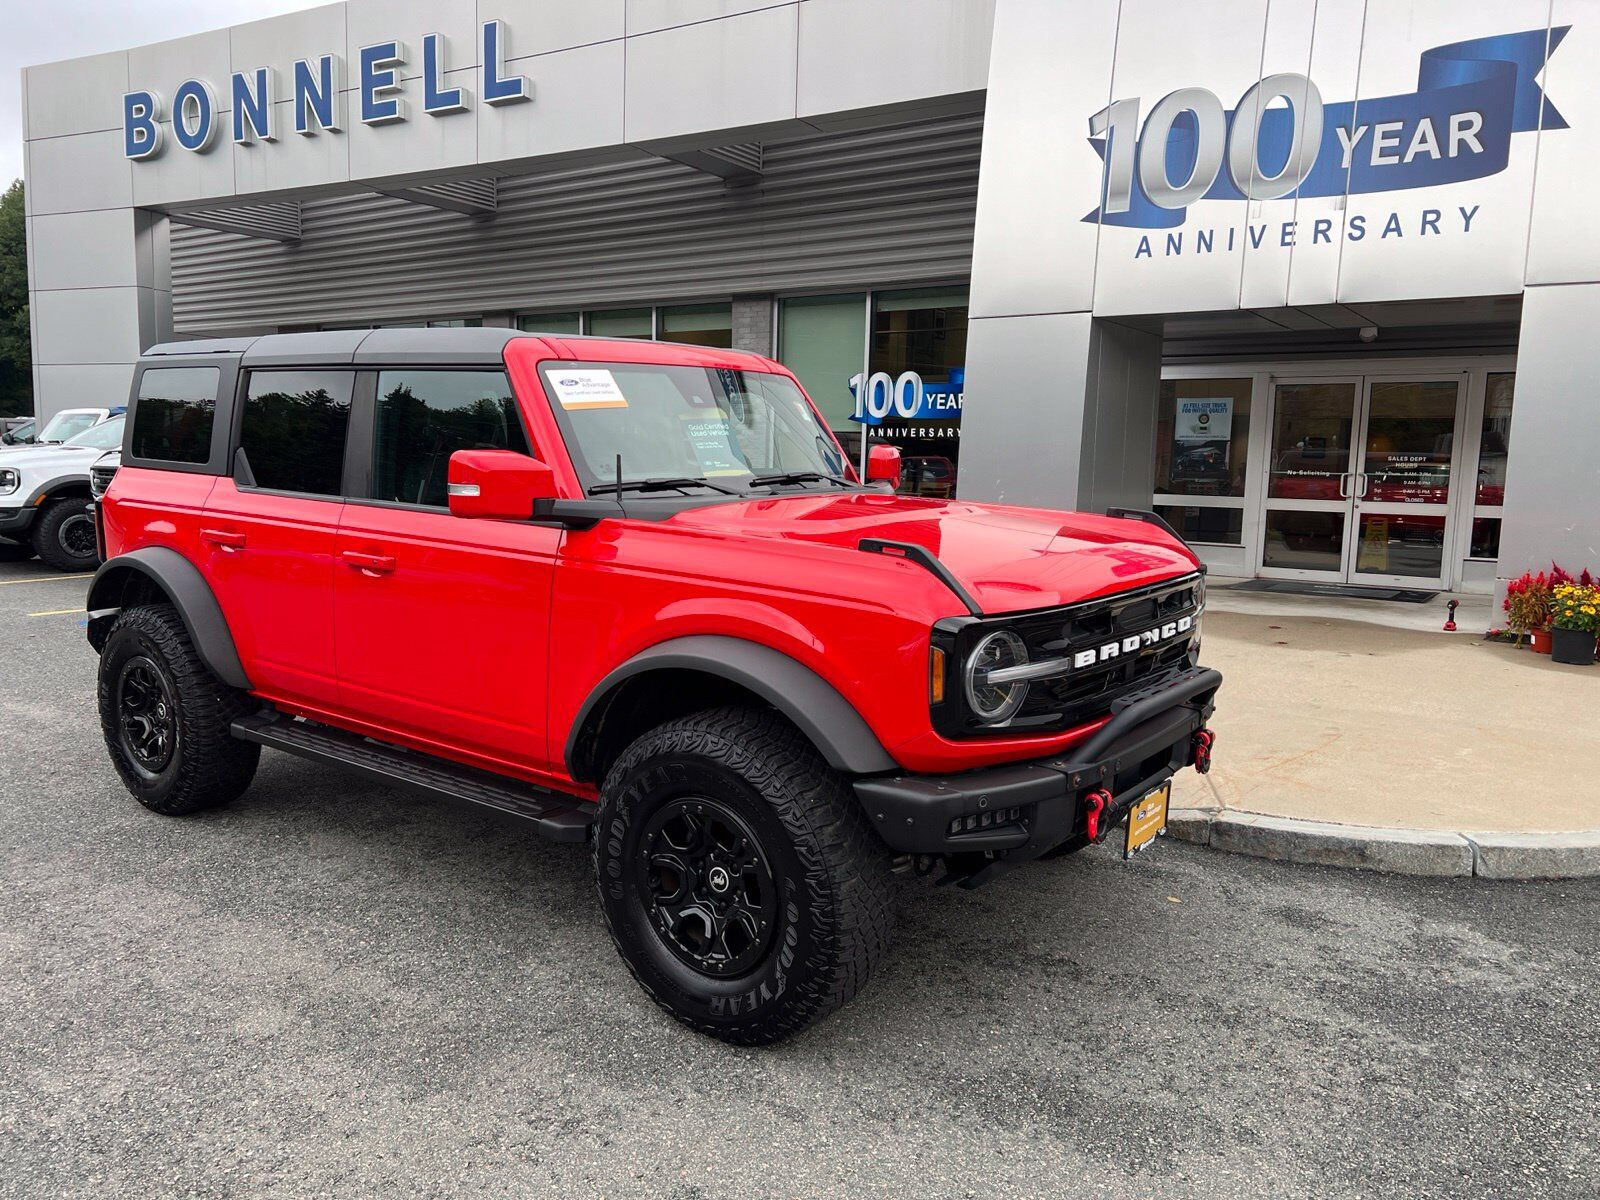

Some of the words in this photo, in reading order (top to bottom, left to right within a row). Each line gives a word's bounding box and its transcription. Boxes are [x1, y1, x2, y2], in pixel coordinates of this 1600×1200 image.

[122, 19, 530, 161] BONNELL
[1088, 72, 1324, 214] 100
[1335, 111, 1485, 169] YEAR
[1135, 204, 1480, 259] ANNIVERSARY
[849, 370, 924, 419] 100
[1074, 616, 1192, 668] BRONCO
